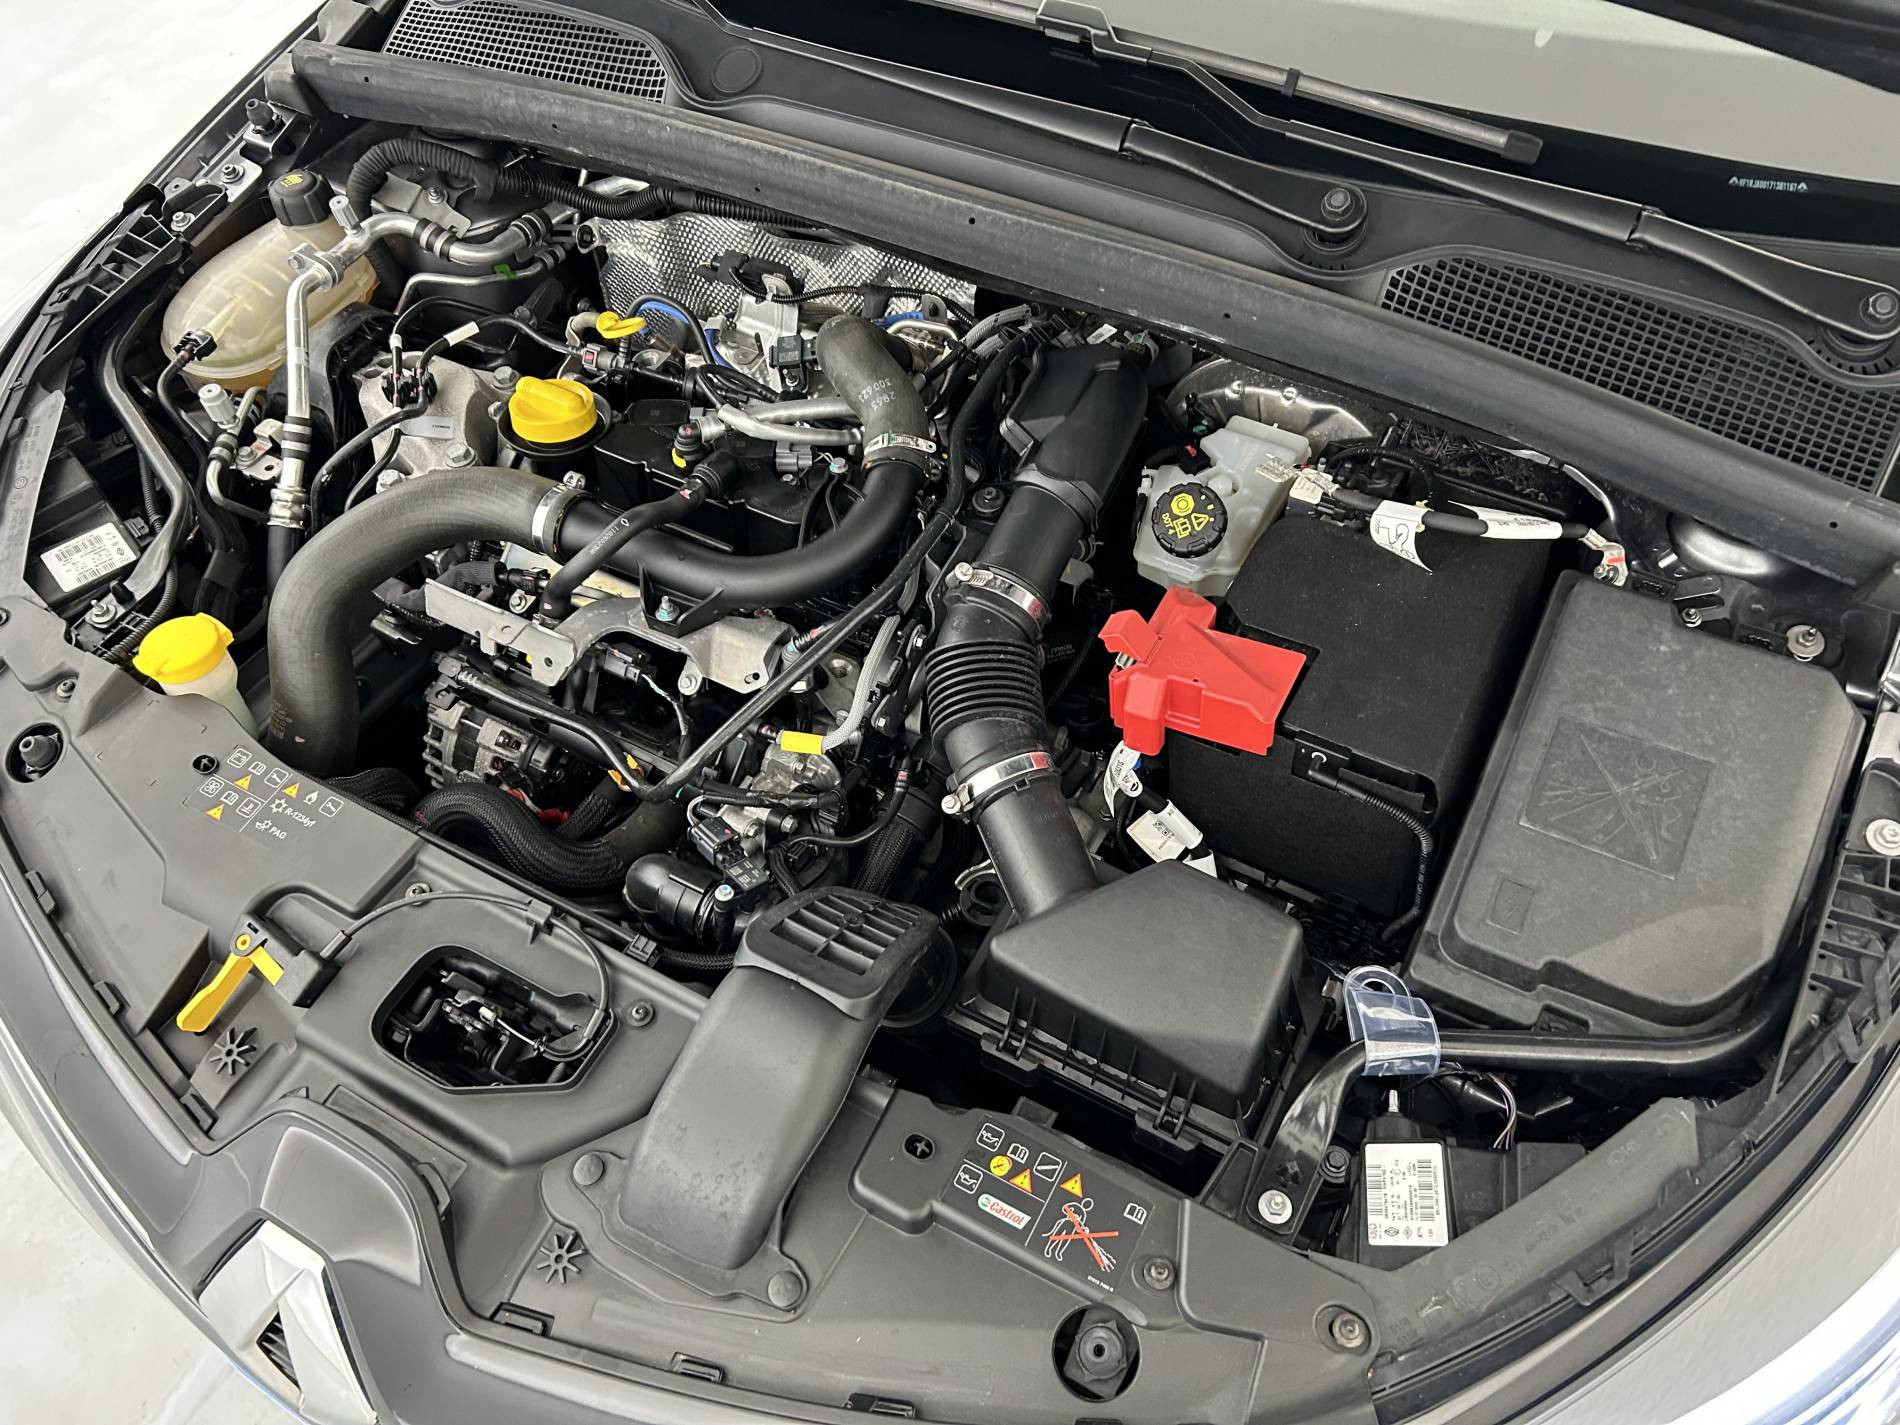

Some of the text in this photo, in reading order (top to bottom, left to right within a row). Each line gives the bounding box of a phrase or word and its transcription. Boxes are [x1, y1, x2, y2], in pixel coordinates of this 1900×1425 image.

[1161, 512, 1174, 528] DOT
[284, 807, 317, 828] R-1234yf
[269, 826, 288, 839] PAG
[989, 1200, 1025, 1226] Castrol
